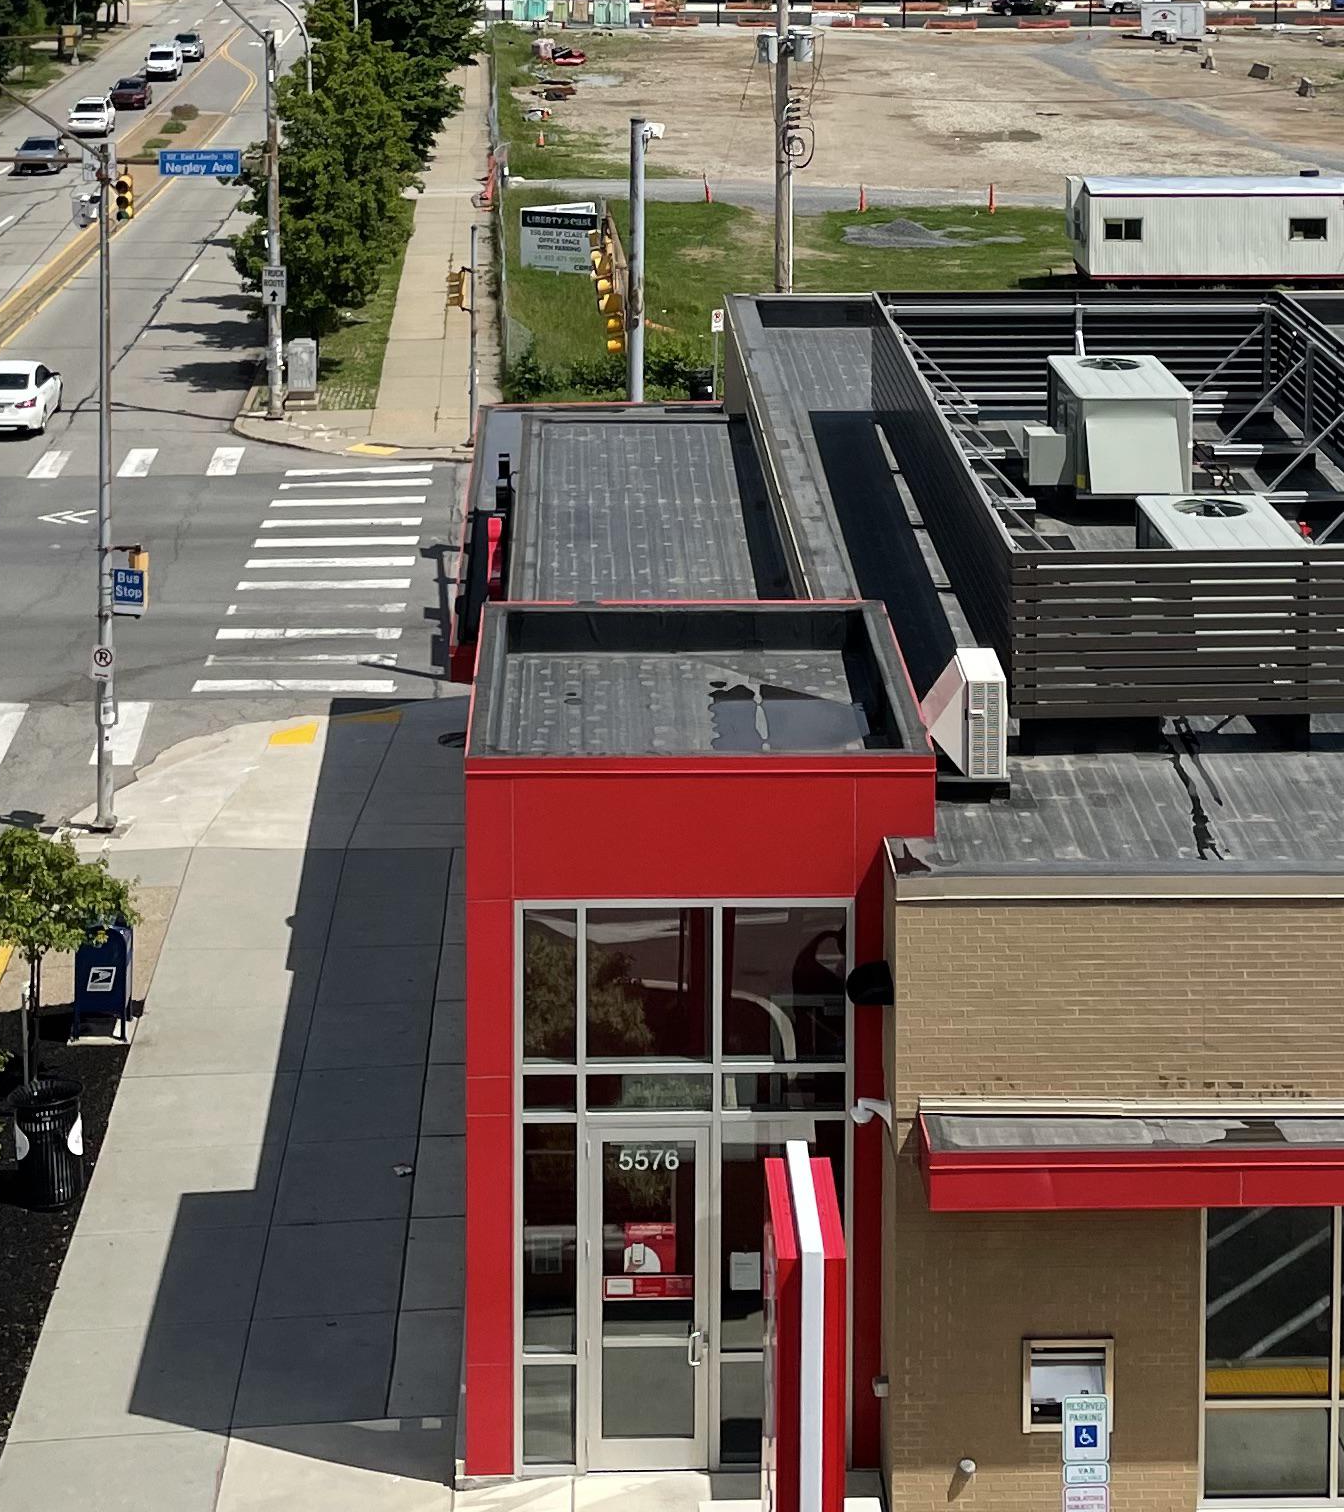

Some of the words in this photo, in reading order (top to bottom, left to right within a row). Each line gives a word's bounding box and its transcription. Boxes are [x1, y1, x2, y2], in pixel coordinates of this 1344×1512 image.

[165, 162, 207, 176] Negley
[211, 162, 234, 173] Ave
[526, 215, 563, 225] LIBERTY
[117, 571, 140, 584] Bus
[116, 585, 143, 599] Stop
[618, 1149, 680, 1171] 5576
[1066, 1401, 1105, 1411] RESERVED
[1069, 1413, 1103, 1422] PARKING
